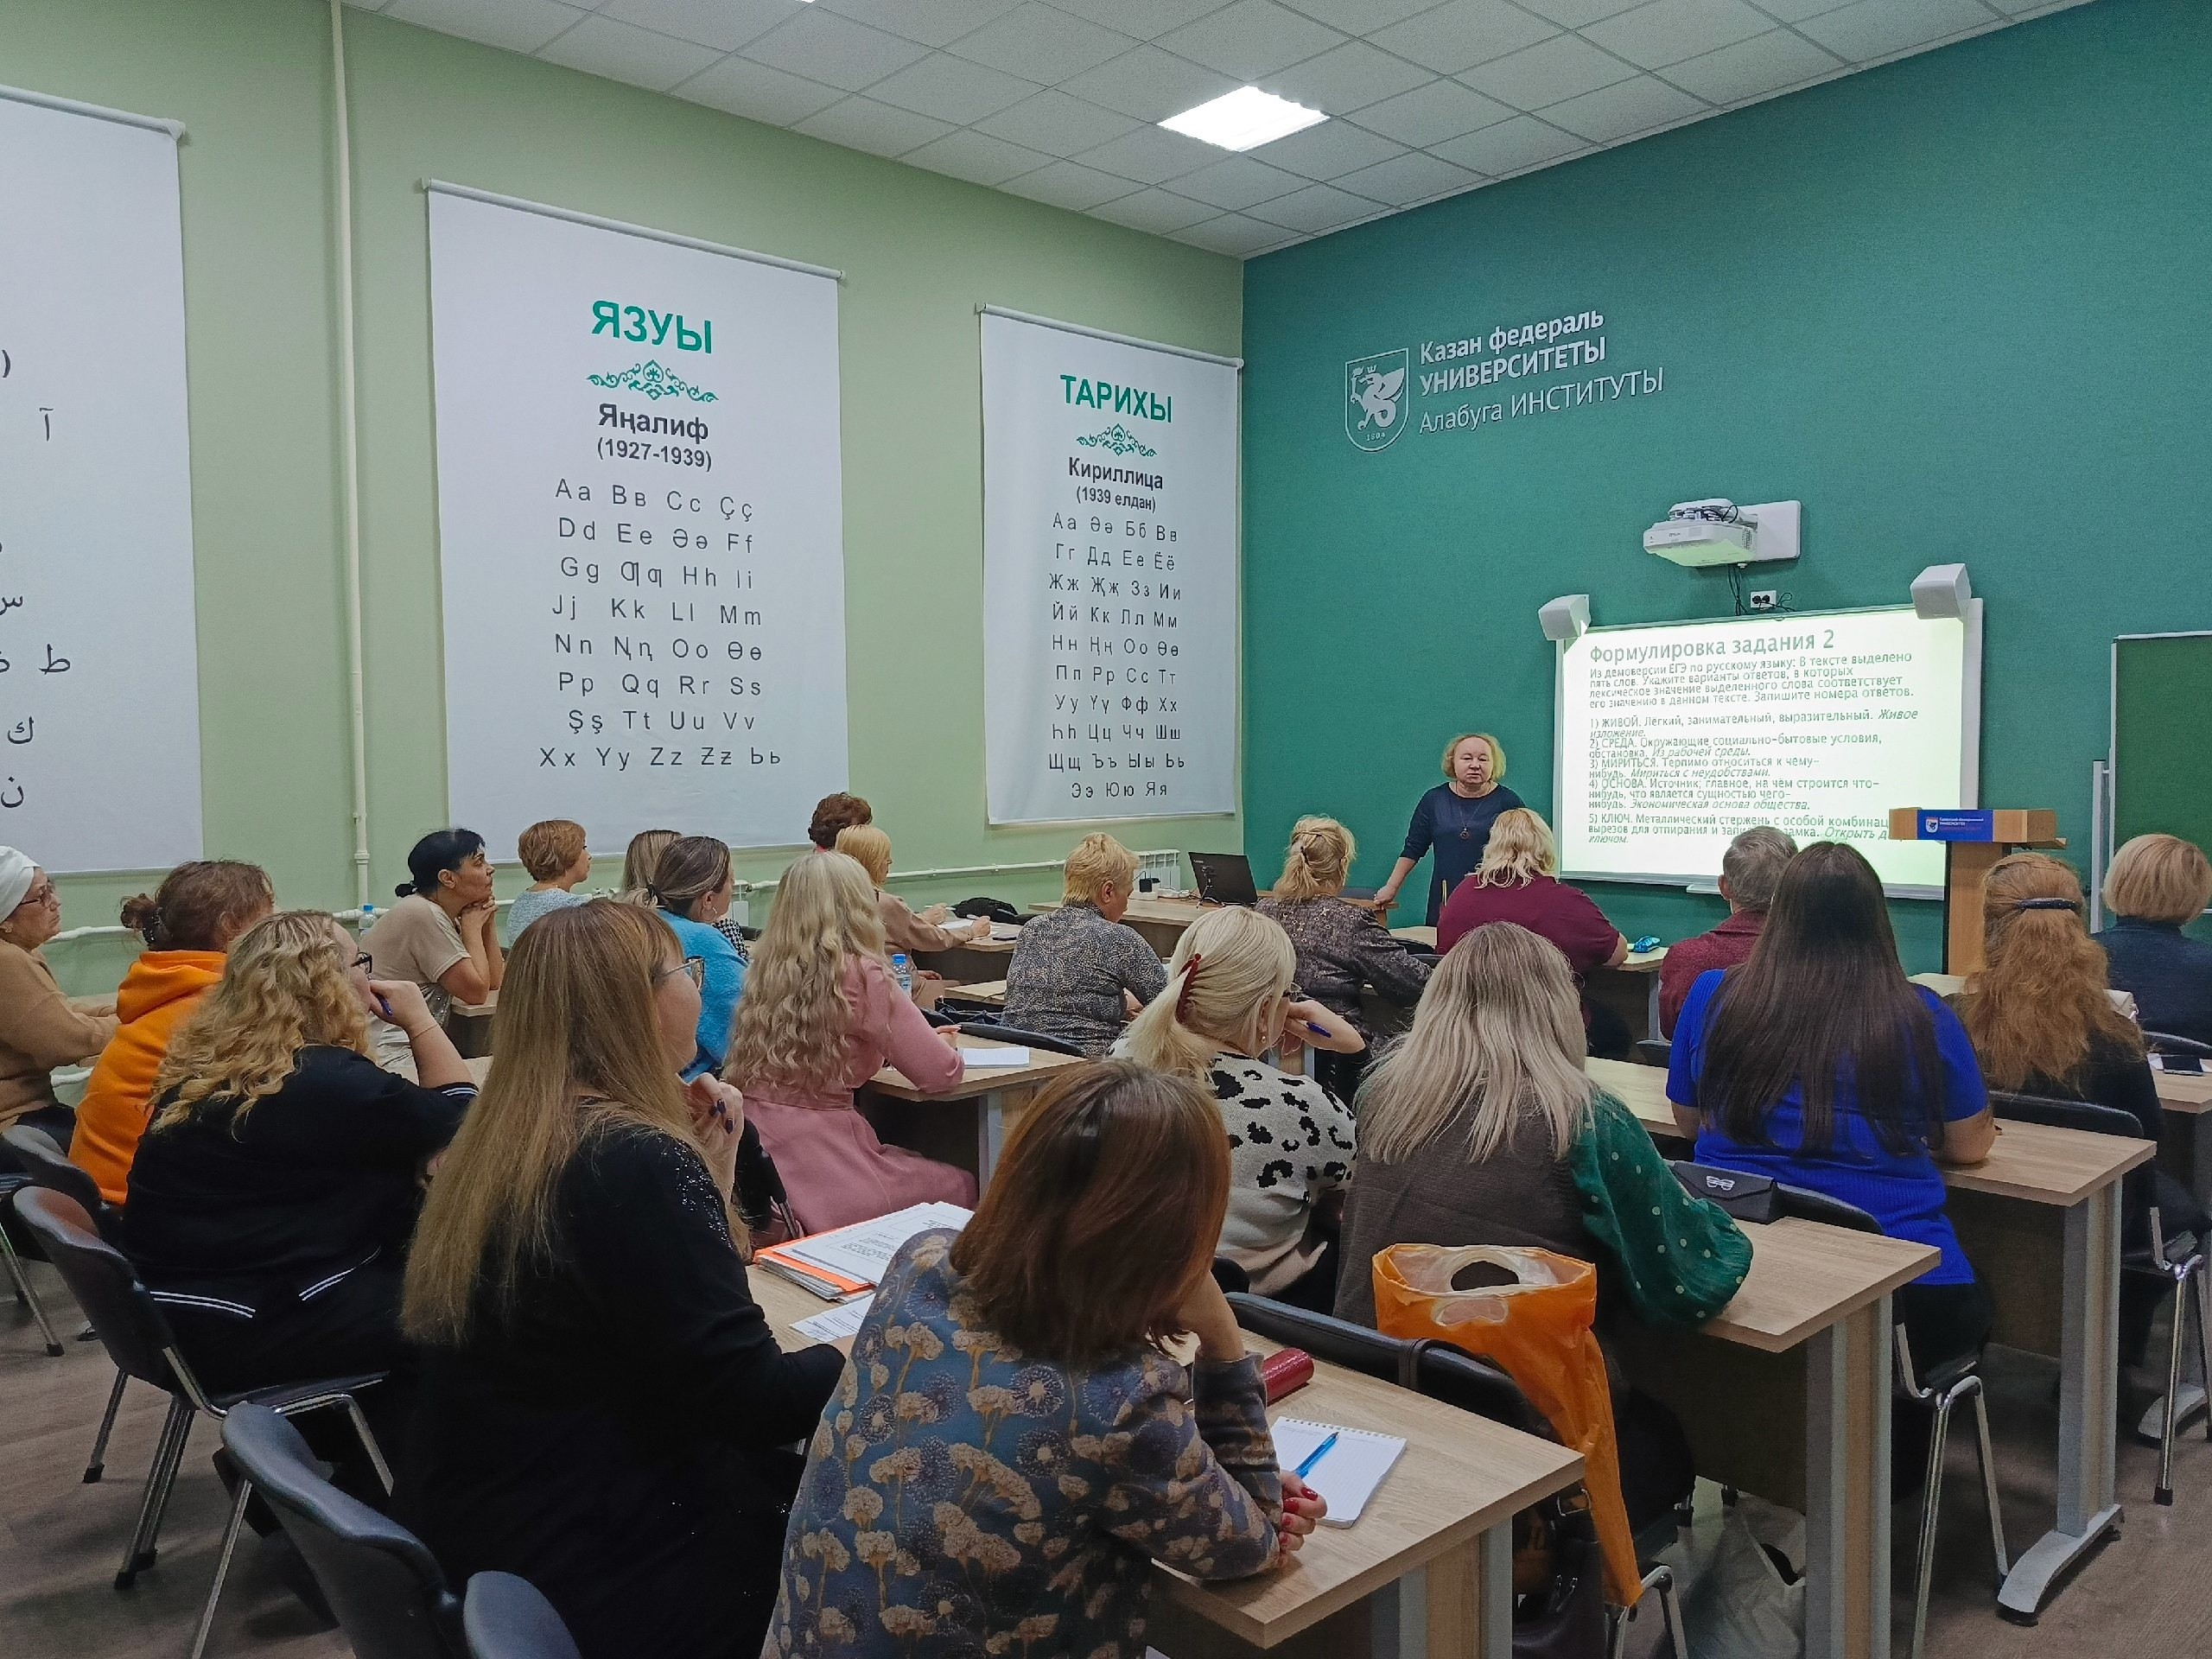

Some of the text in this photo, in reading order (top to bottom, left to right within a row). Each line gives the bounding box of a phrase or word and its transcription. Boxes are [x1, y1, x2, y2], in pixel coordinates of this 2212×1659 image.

[592, 301, 711, 353] ЯЗУЫ
[1421, 310, 1603, 365] Казан федераль
[1420, 337, 1605, 396] УНИВЕРСИТЕТЫ
[1060, 375, 1171, 423] ТАРИХЫ
[1420, 367, 1662, 433] Алабуга ИНСТИТУТЫ
[599, 404, 708, 444] Яңалиф
[598, 437, 711, 472] (1927-1939)
[1070, 457, 1162, 491] Кириллица
[1077, 486, 1155, 513] (1939 елдан)
[1591, 629, 1834, 664] Формулировка задания 2
[1590, 669, 1602, 678] Из
[1605, 666, 1666, 681] демоверсии
[1669, 663, 1687, 673] ЕГЭ
[1707, 661, 1757, 674] русскому
[1810, 657, 1847, 666] тексте
[1852, 652, 1911, 664] выделено
[1590, 679, 1611, 688] пять
[1643, 675, 1686, 686] Укажите
[1689, 674, 1739, 684] варианты
[1804, 667, 1853, 679] которых
[1590, 677, 1902, 698] лексическое значение выделенного слова соответствует
[1609, 698, 1656, 708] значению
[1669, 696, 1708, 705] данном
[1754, 690, 1810, 702] Запишите
[1815, 690, 1858, 700] номера
[1878, 709, 1918, 720] Живое
[1640, 738, 1709, 749] Окружающие
[1713, 733, 1827, 746] социально-бытовые
[1668, 746, 1711, 758] рабочей
[1662, 758, 1708, 769] Терпимо
[1712, 757, 1772, 766] относиться
[1630, 769, 1680, 779] Мириться
[1796, 779, 1848, 790] строится
[1630, 799, 1708, 809] Экономическая
[1697, 790, 1756, 799] сущностью
[1636, 814, 1715, 824] Металлический
[1719, 817, 1770, 825] стержень
[1783, 815, 1823, 825] особой
[1589, 825, 1628, 834] вырезов
[1653, 826, 1707, 836] отпирания
[1825, 827, 1874, 839] Открыть
